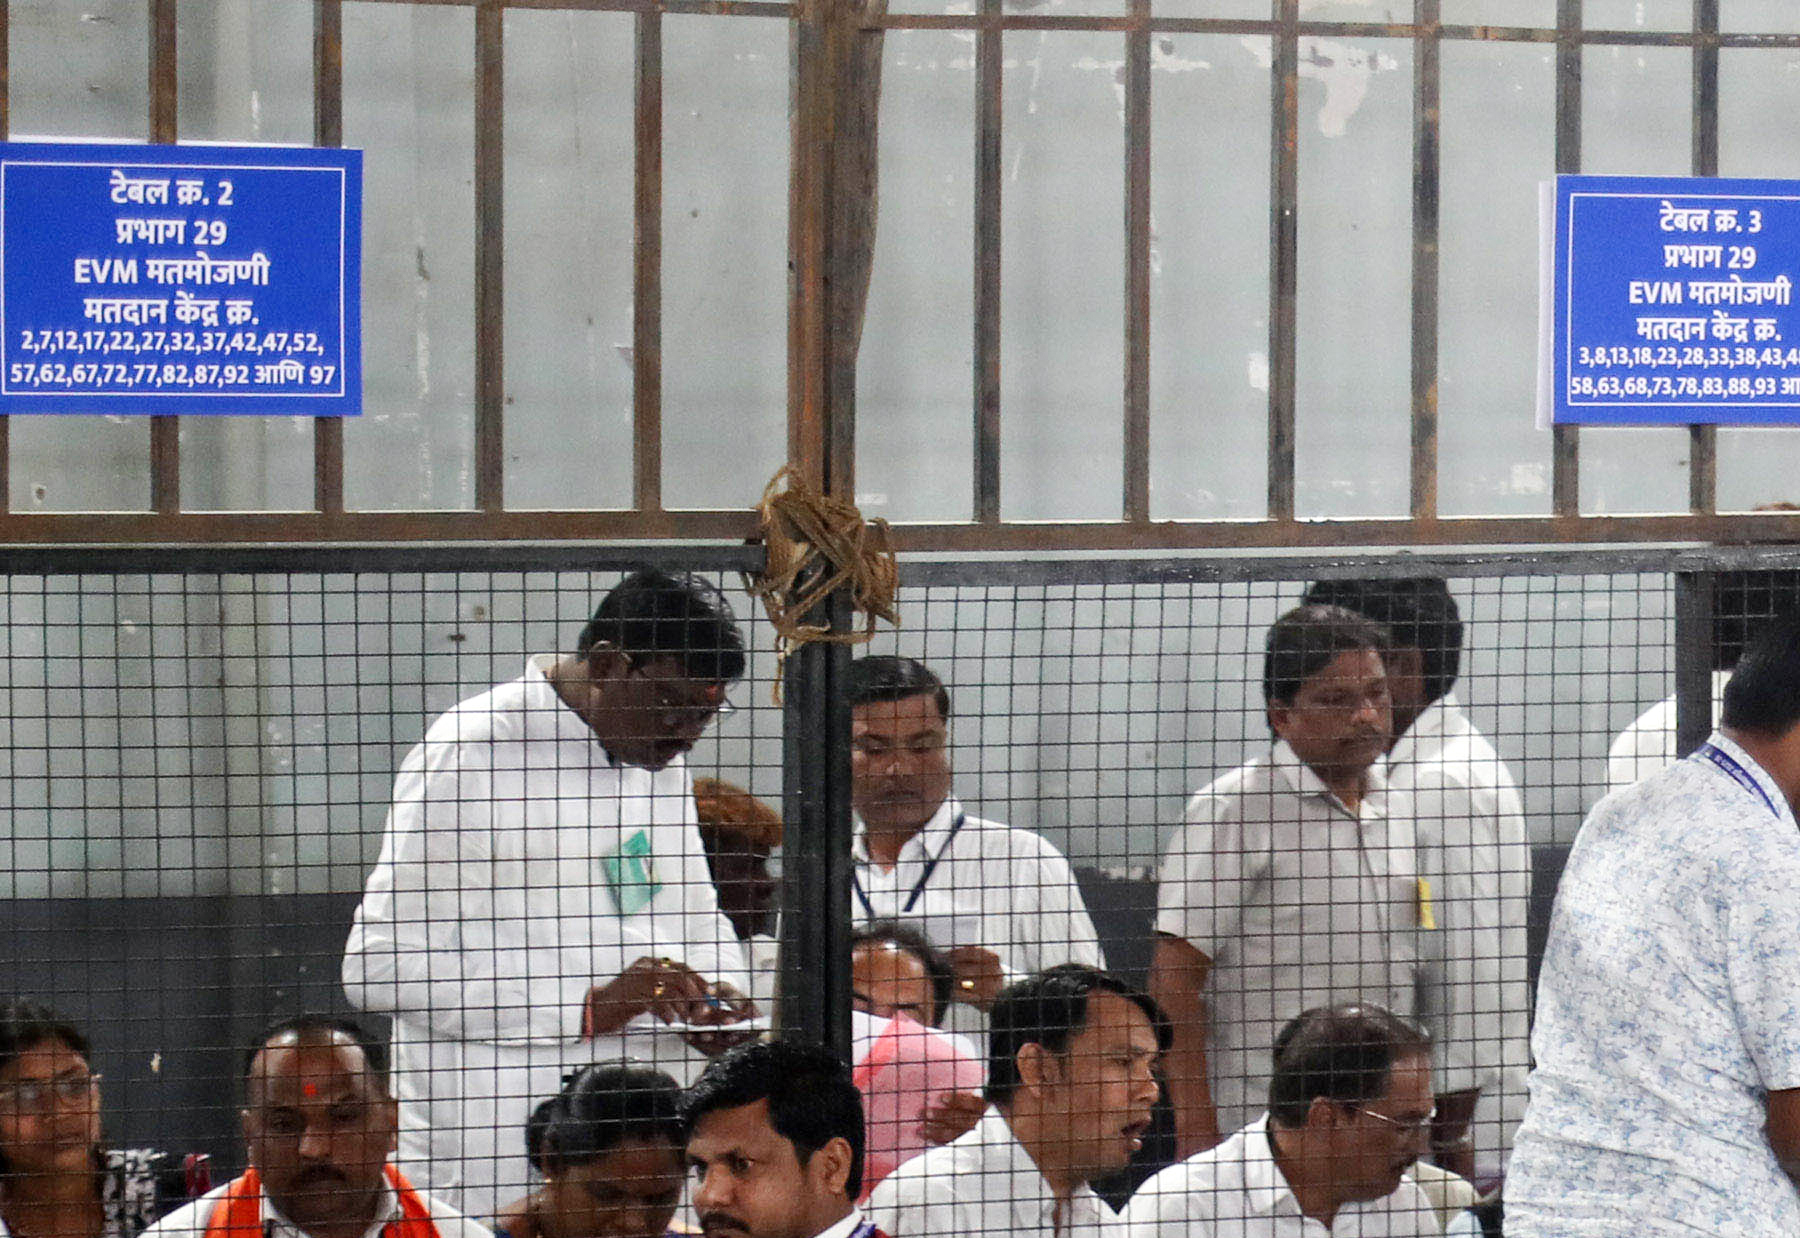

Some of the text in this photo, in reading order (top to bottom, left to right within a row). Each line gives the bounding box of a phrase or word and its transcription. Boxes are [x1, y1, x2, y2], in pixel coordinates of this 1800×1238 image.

[109, 168, 234, 206] टेबल क्र. 2
[115, 218, 228, 246] प्रभाग 29
[1659, 199, 1762, 234] टेबल क्र. 3
[74, 250, 271, 286] EVM मतमोजणी
[1663, 244, 1757, 270] प्रभाग 29
[1629, 273, 1792, 306] EVM मतमोजणी
[83, 289, 259, 327] मतदान केंद्र क्र.
[21, 329, 324, 357] 2,7,12,17,22,27,32,37,42,47,52,
[1636, 309, 1782, 344] मतदान केंद्र क्र.
[10, 358, 336, 389] 57,62,67,72,77,82,87,92 आणि 97
[1569, 376, 1777, 399] 58,63,68,73,78,83,88,93
